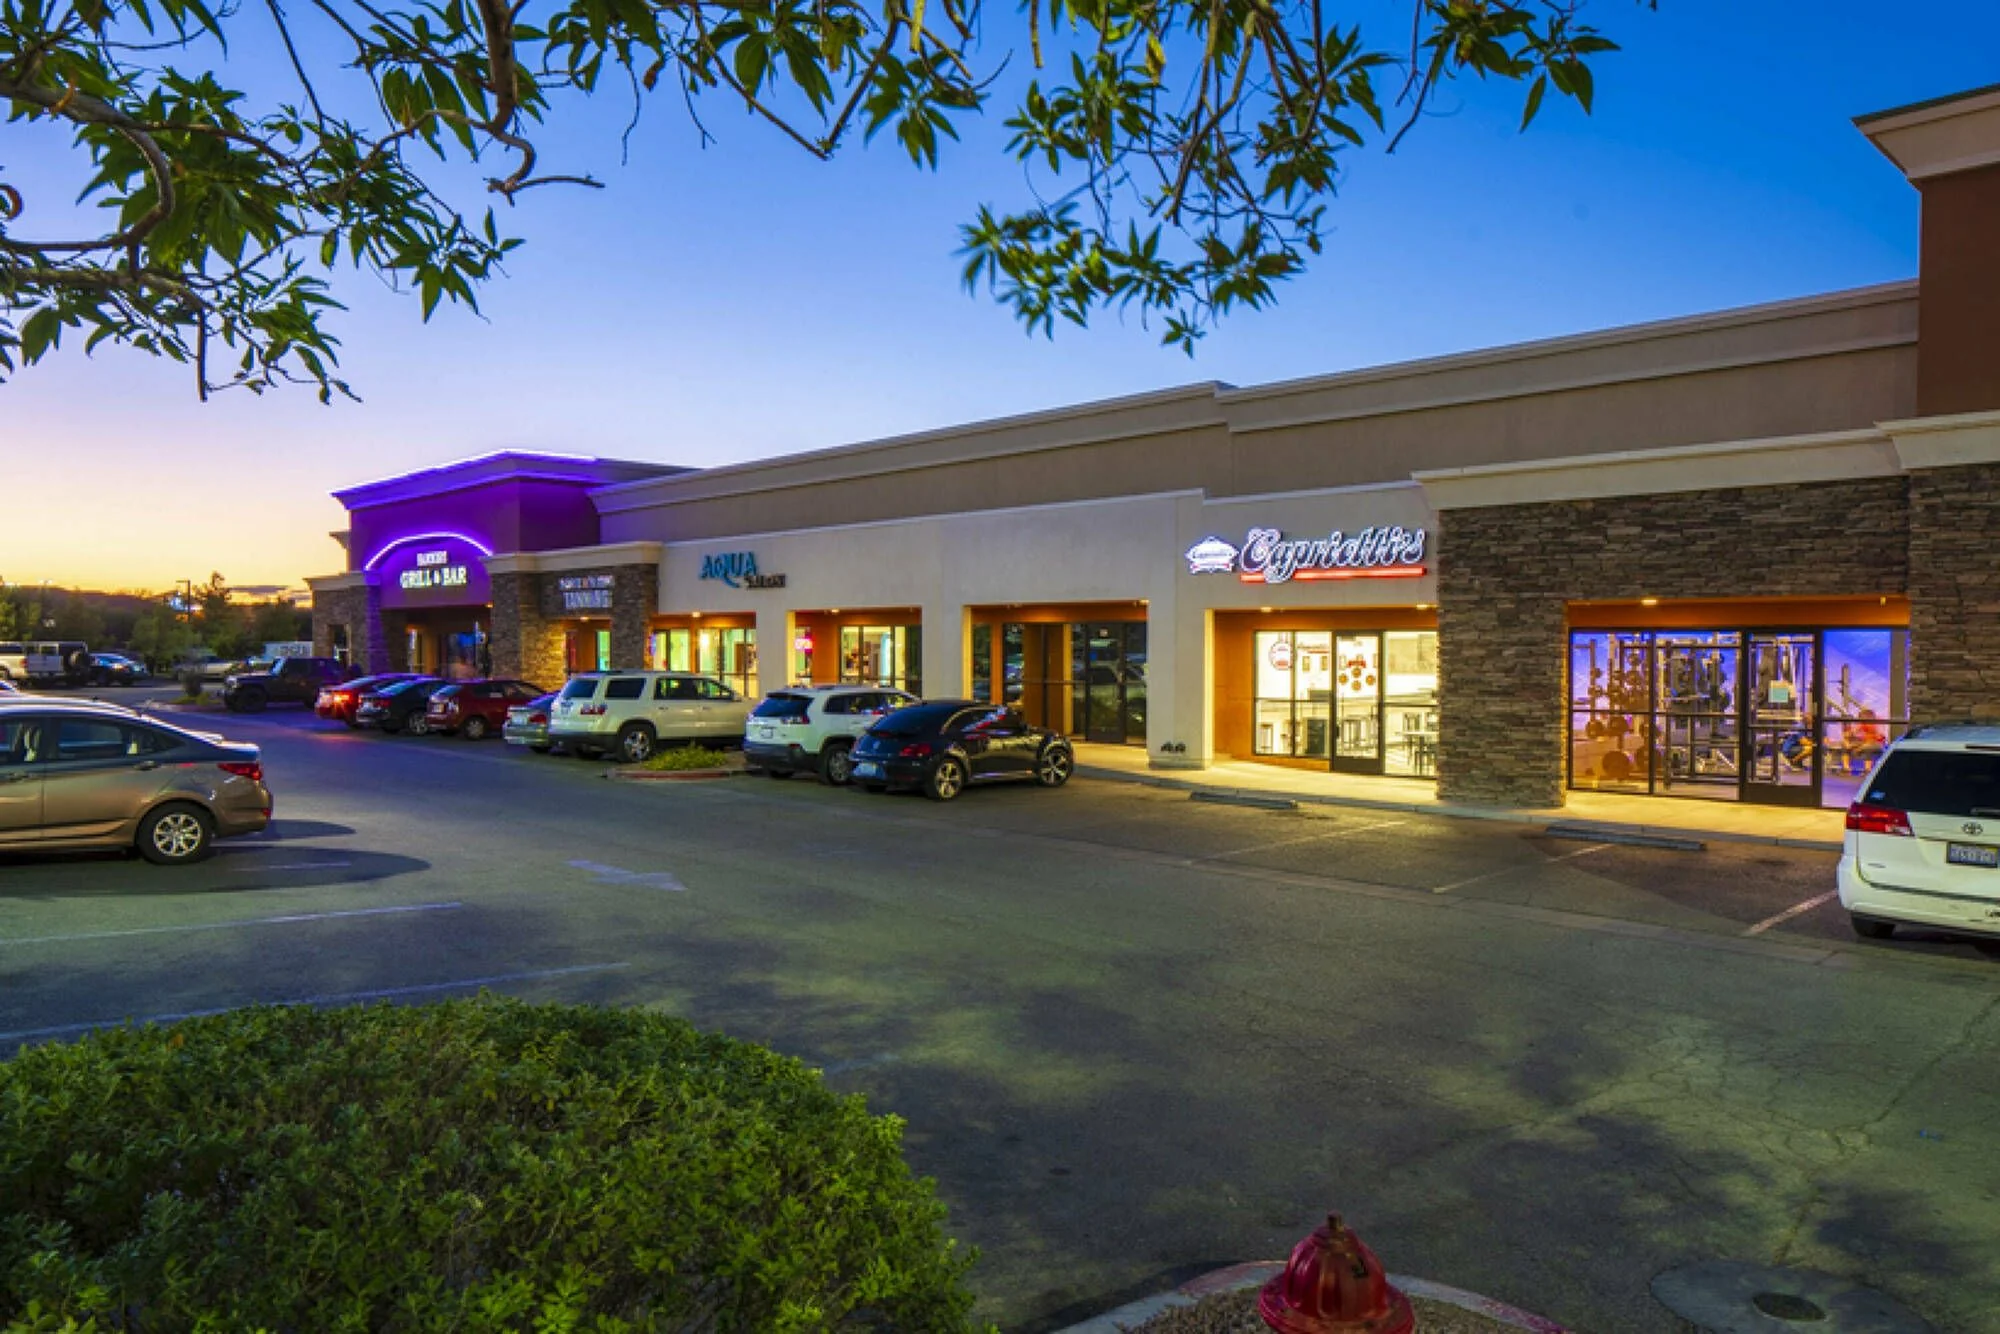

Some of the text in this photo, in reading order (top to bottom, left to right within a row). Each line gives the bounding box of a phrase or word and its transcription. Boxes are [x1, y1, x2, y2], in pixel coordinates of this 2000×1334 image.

[400, 569, 432, 588] GRILL
[441, 565, 467, 586] BAR
[700, 551, 757, 588] AQUA
